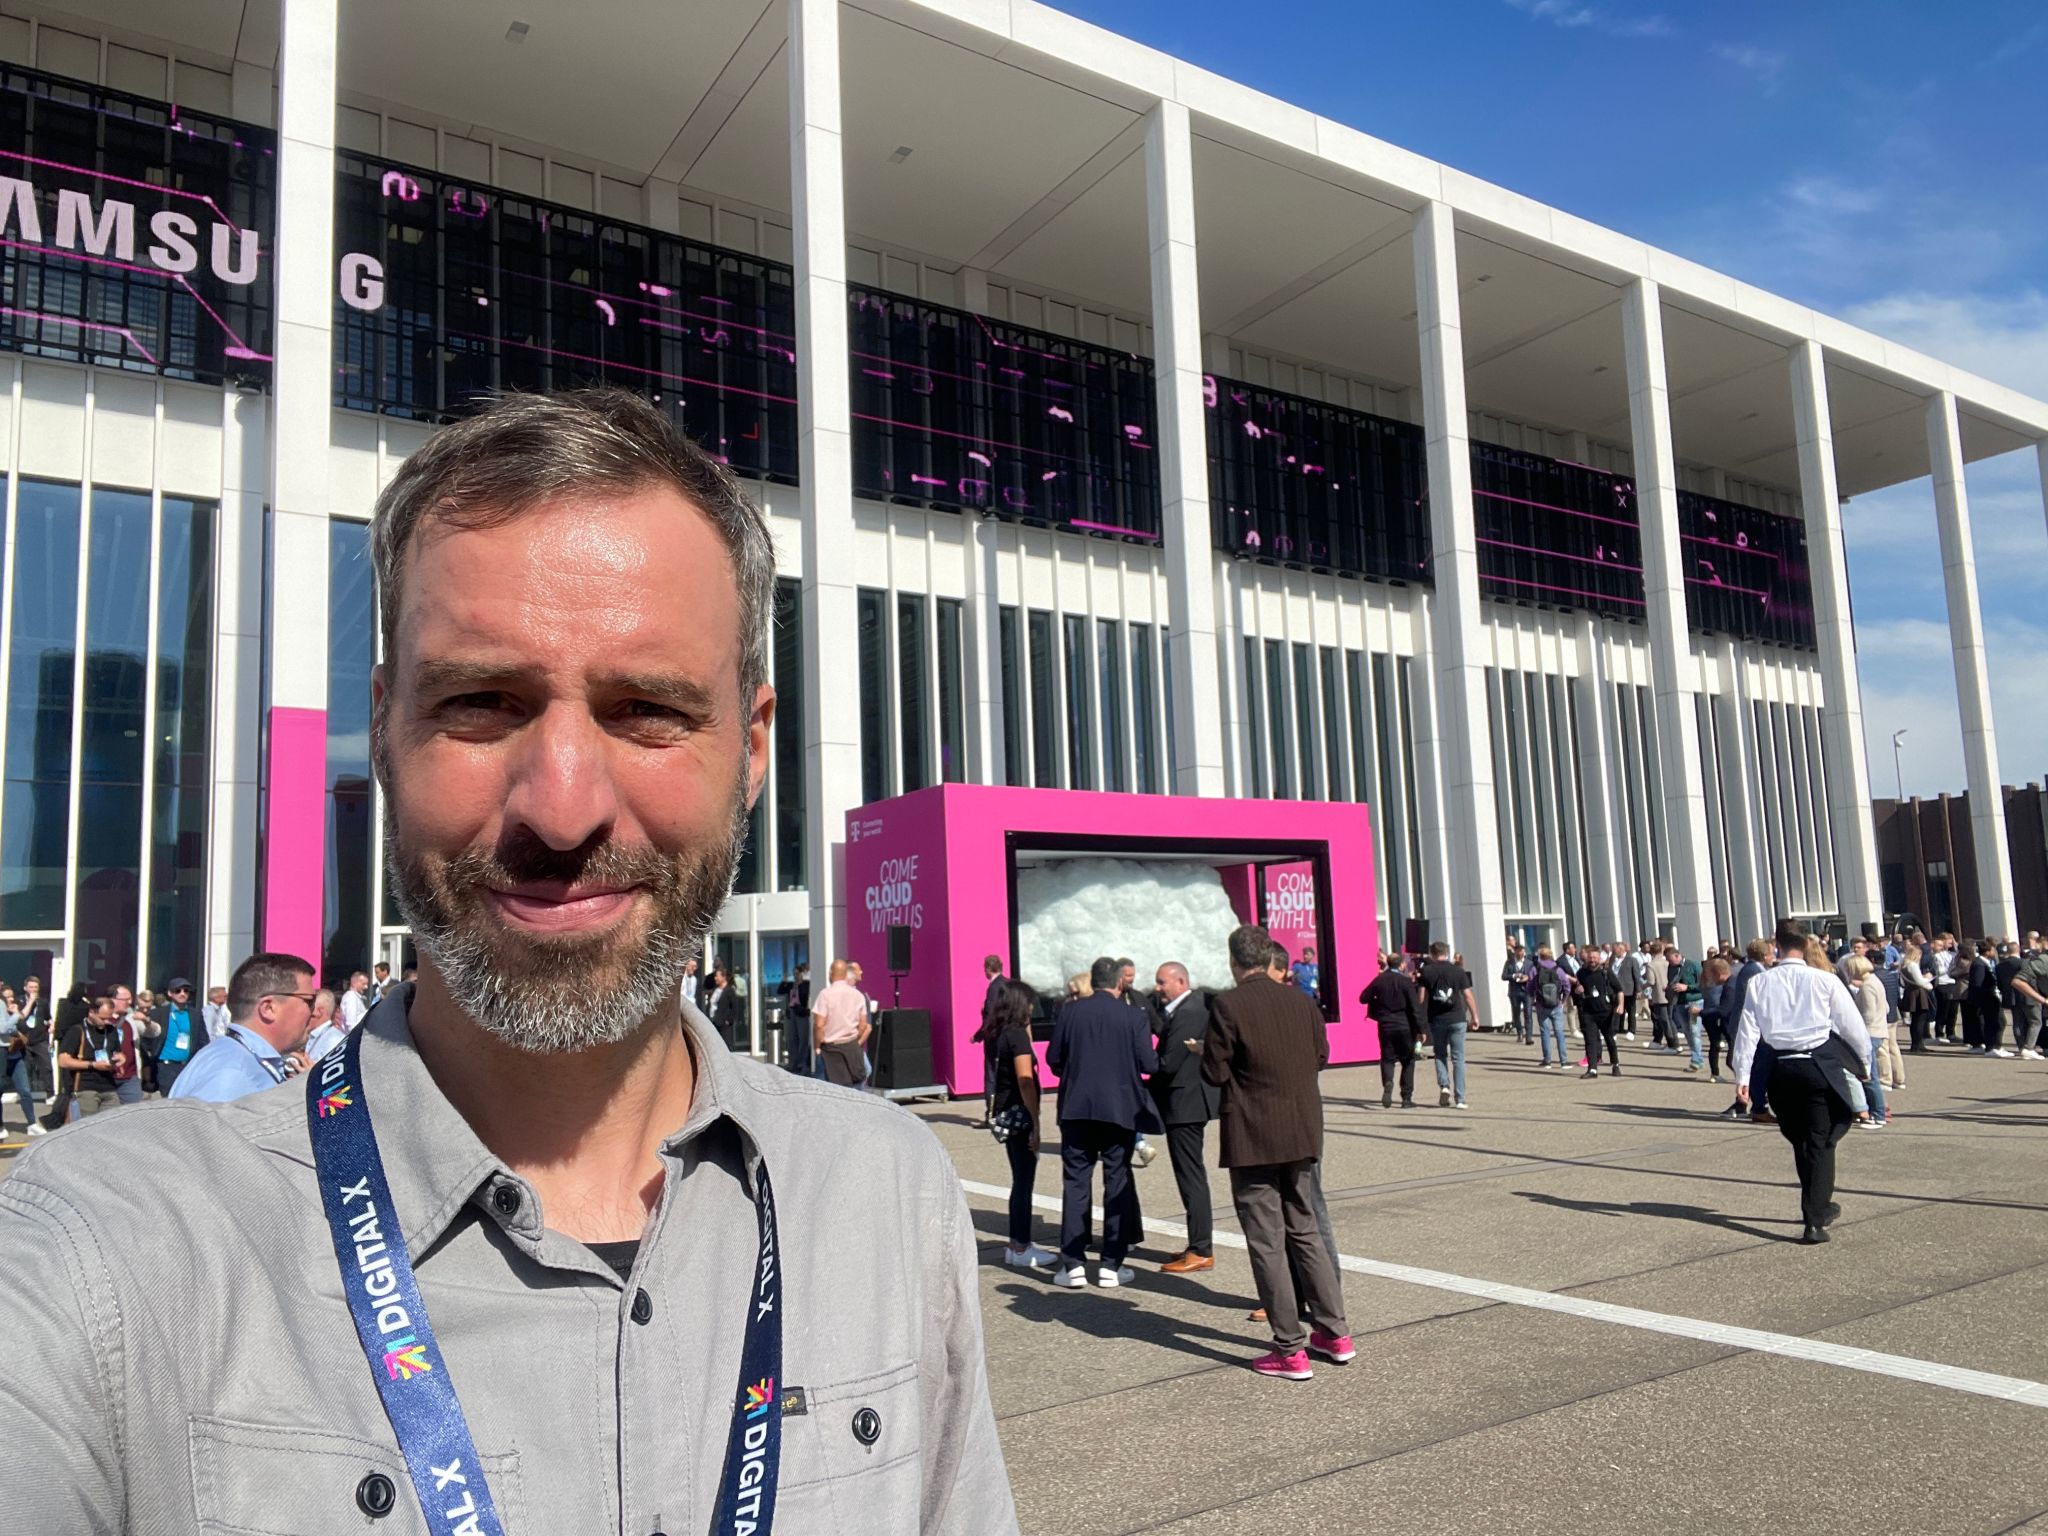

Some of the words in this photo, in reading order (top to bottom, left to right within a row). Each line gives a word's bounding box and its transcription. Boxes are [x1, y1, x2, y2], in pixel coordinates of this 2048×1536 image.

[0, 176, 384, 310] AMSUG
[880, 854, 919, 885] COME
[1277, 872, 1314, 892] COM
[865, 881, 912, 911] CLOUD
[870, 907, 903, 933] WITH
[340, 1176, 371, 1205] X
[759, 1178, 775, 1297] DIGITAL
[349, 1200, 411, 1335] DIGITAL
[756, 1292, 774, 1324] X
[430, 1457, 467, 1493] X
[733, 1421, 769, 1536] DIGITA
